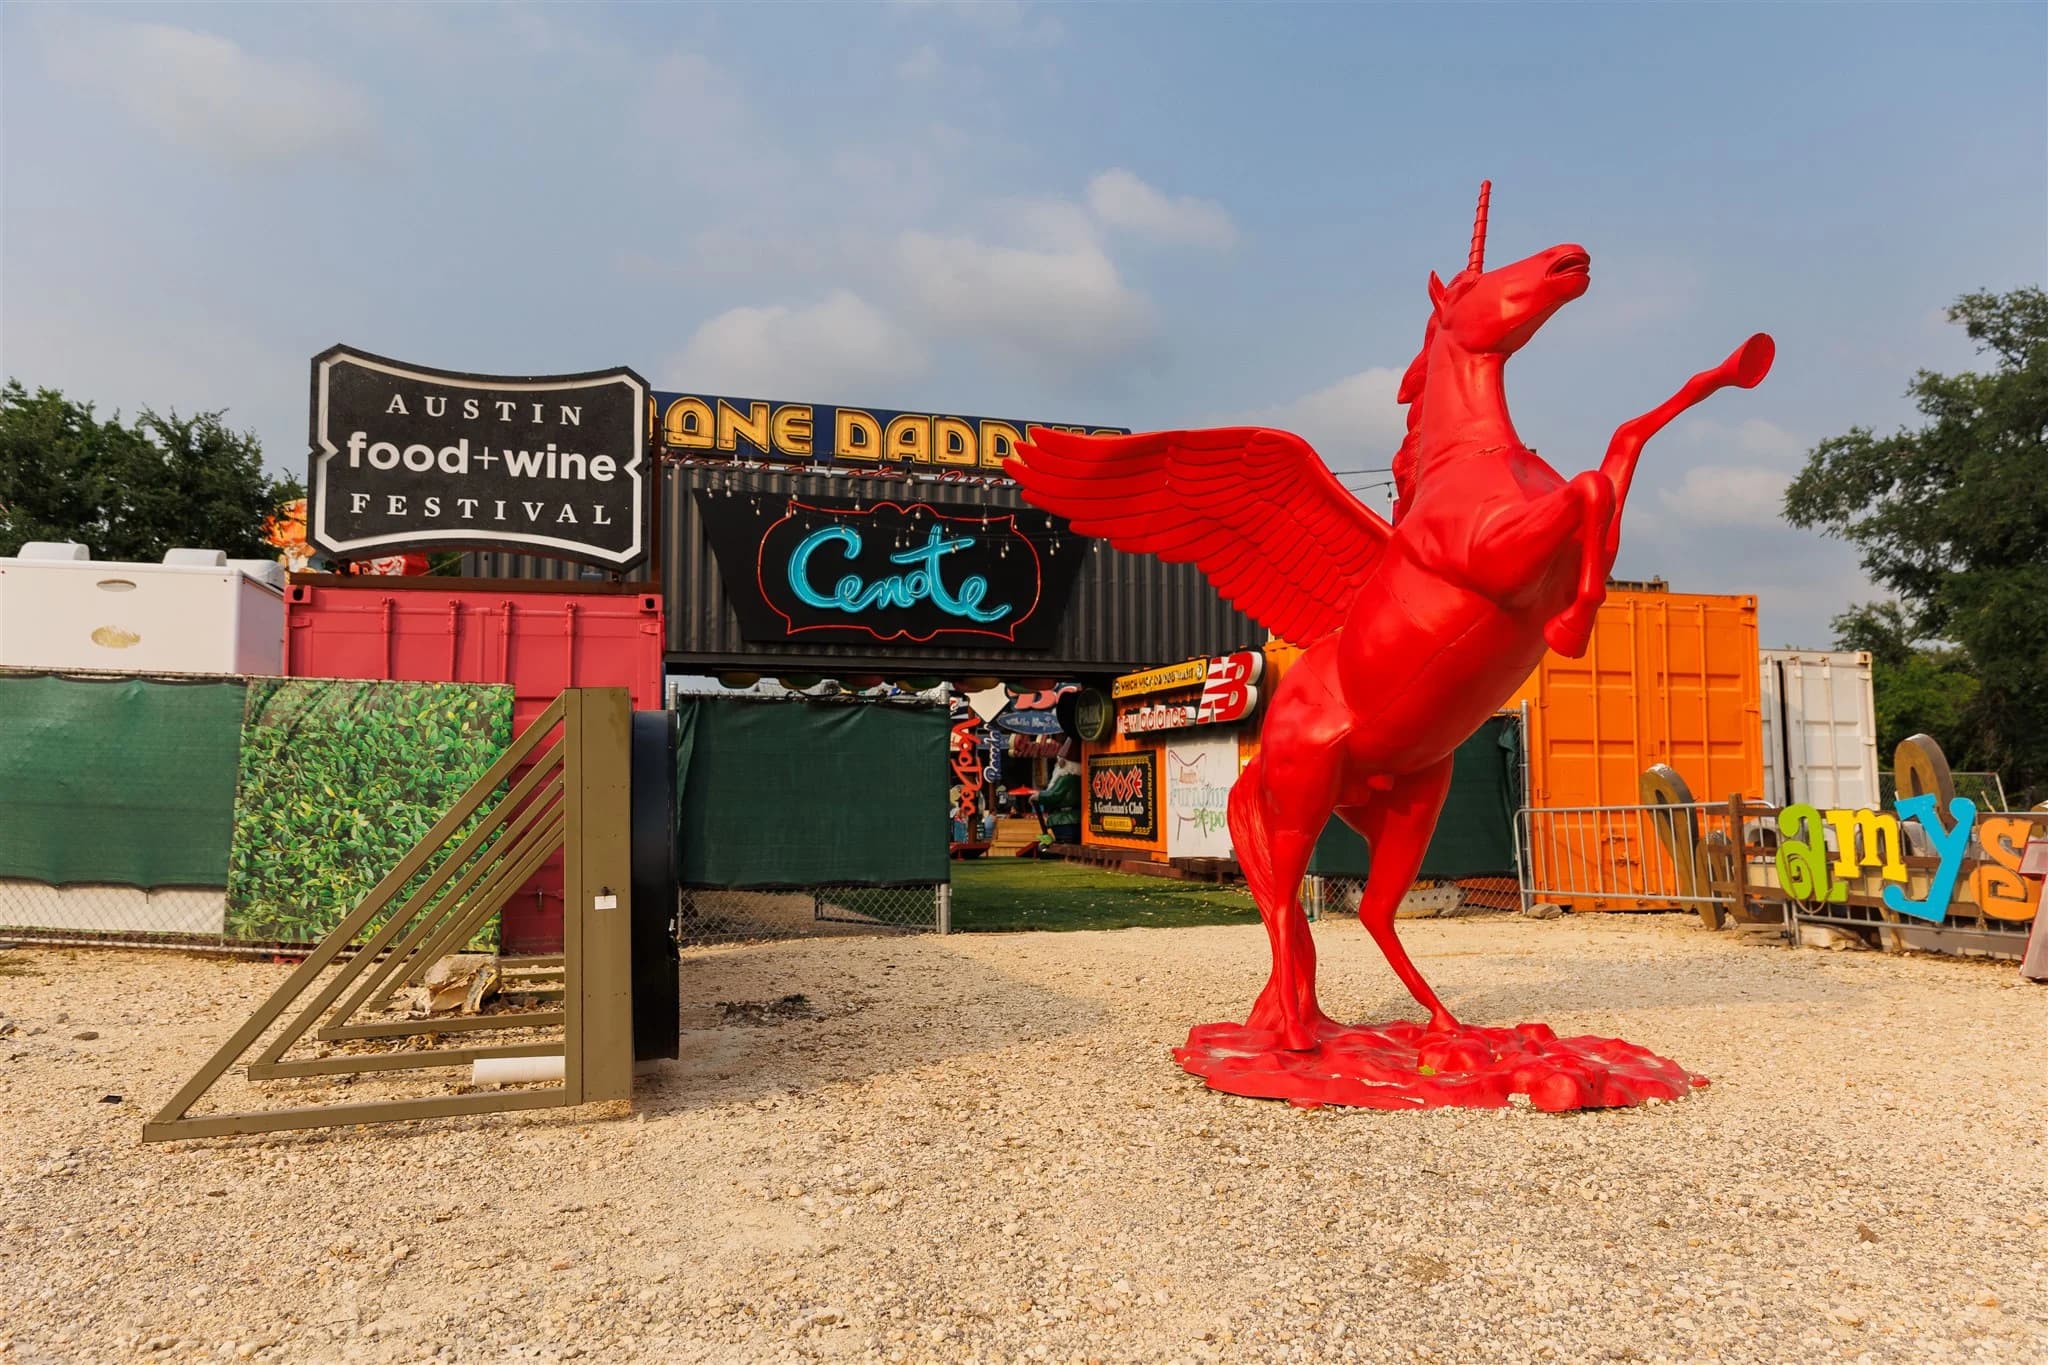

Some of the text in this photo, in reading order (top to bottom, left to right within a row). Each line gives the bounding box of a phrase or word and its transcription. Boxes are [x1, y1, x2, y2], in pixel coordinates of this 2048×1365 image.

[386, 393, 583, 426] AUSTIN
[648, 395, 814, 456] ONE
[347, 431, 617, 481] food+wine
[350, 493, 611, 525] FESTIVAL
[788, 523, 1012, 623] Cenote
[1117, 705, 1188, 733] new balance
[1094, 802, 1099, 813] A
[1129, 802, 1145, 815] Club
